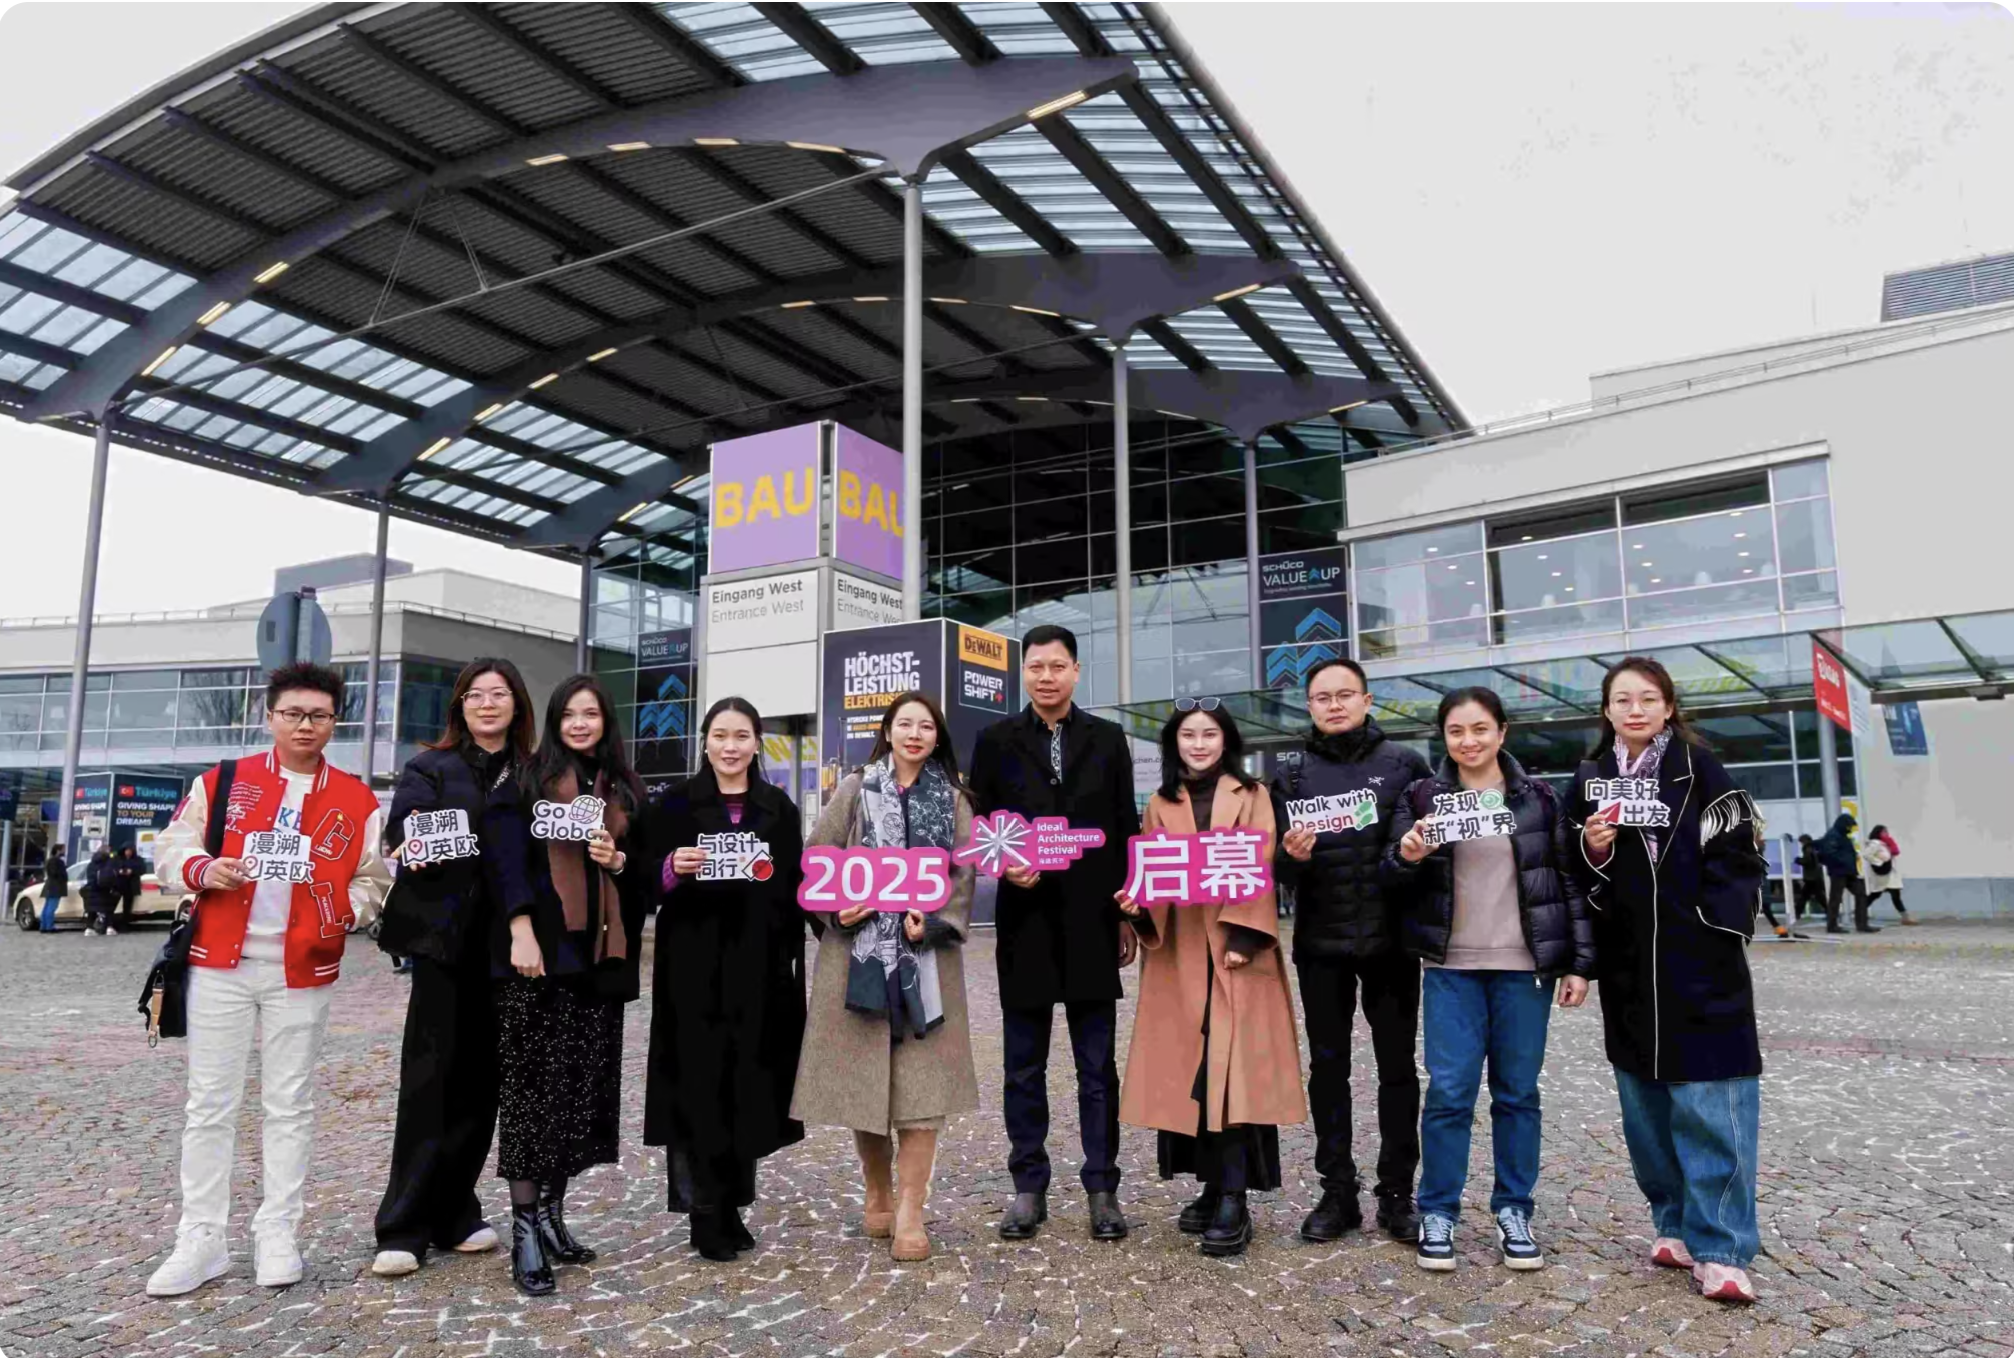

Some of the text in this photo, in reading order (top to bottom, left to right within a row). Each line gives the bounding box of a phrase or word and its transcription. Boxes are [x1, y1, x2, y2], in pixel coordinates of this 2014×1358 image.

[714, 467, 815, 528] BAU
[1263, 567, 1341, 587] VALUE UP
[712, 579, 803, 603] Eingang West
[837, 578, 877, 604] Eingang
[711, 599, 804, 623] Entrance West
[837, 597, 879, 623] Entrance
[641, 643, 689, 657] VALUE UP
[844, 651, 920, 678] HÖCHST-
[844, 671, 920, 696] LEISTUNG
[964, 670, 1003, 691] POWER
[964, 684, 996, 702] SHIFT
[1587, 778, 1658, 800] 向美好
[117, 802, 148, 810] GIVING
[534, 801, 566, 819] Go
[1288, 789, 1376, 816] Walk with
[1434, 792, 1480, 817] 发现
[115, 817, 152, 826] DREAMS
[131, 810, 155, 818] YOUR
[411, 810, 459, 838] 漫溯
[1624, 804, 1669, 826] 出发
[1037, 821, 1063, 832] Ideal
[250, 832, 301, 856] 漫溯
[430, 834, 480, 861] 英欧
[698, 833, 759, 854] 与设计
[1038, 833, 1100, 843] Architecture
[1038, 845, 1077, 855] Festival
[263, 860, 314, 883] 英欧
[697, 858, 738, 879] 同行
[1128, 832, 1266, 901] 启幕
[805, 856, 946, 902] 2025
